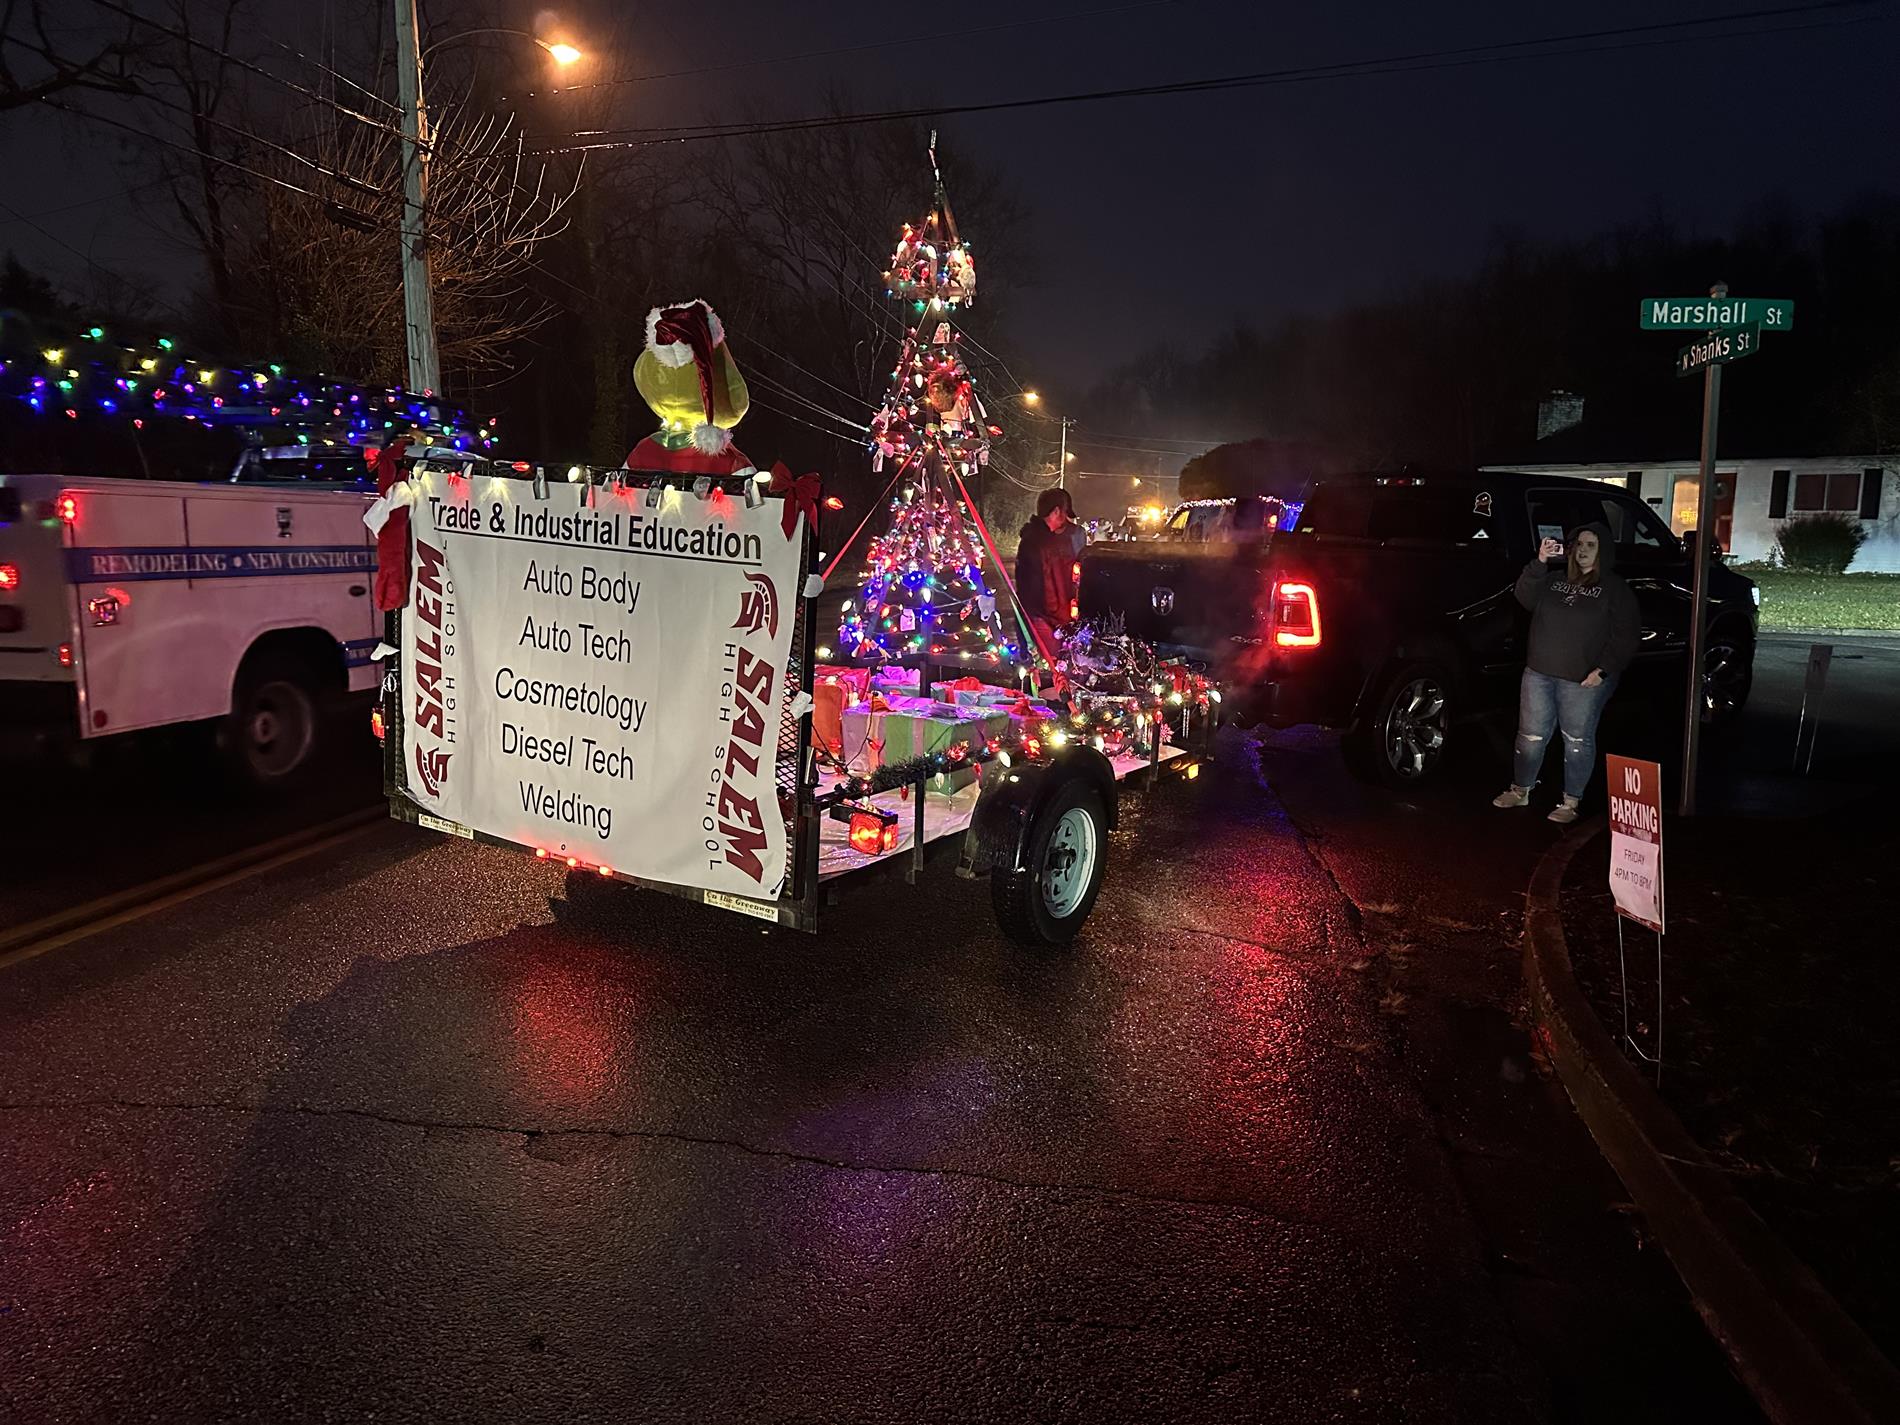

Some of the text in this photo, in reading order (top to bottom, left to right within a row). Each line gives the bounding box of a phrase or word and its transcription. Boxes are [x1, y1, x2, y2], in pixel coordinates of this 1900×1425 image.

[1652, 301, 1783, 325] Marshall St
[1682, 332, 1750, 370] N Shanks St
[429, 497, 762, 560] Trade & Industrial Education
[92, 554, 227, 576] REMODELING
[248, 552, 282, 570] NEW
[524, 560, 641, 614] Auto Body
[415, 537, 446, 739] SALEM
[519, 616, 632, 663] Auto Tech
[444, 676, 458, 744] HIGH
[495, 668, 648, 733] Cosmetology
[502, 723, 635, 780] Diesel Tech
[702, 642, 737, 872] HIGH SCHOOL
[718, 647, 775, 885] SALEM
[1624, 767, 1641, 795] NO
[519, 780, 613, 840] Welding
[1610, 796, 1659, 834] PARKING
[1614, 868, 1630, 882] 4PM
[1630, 870, 1639, 885] TO
[1624, 848, 1645, 865] FRIDAY
[735, 899, 776, 915] Greenway
